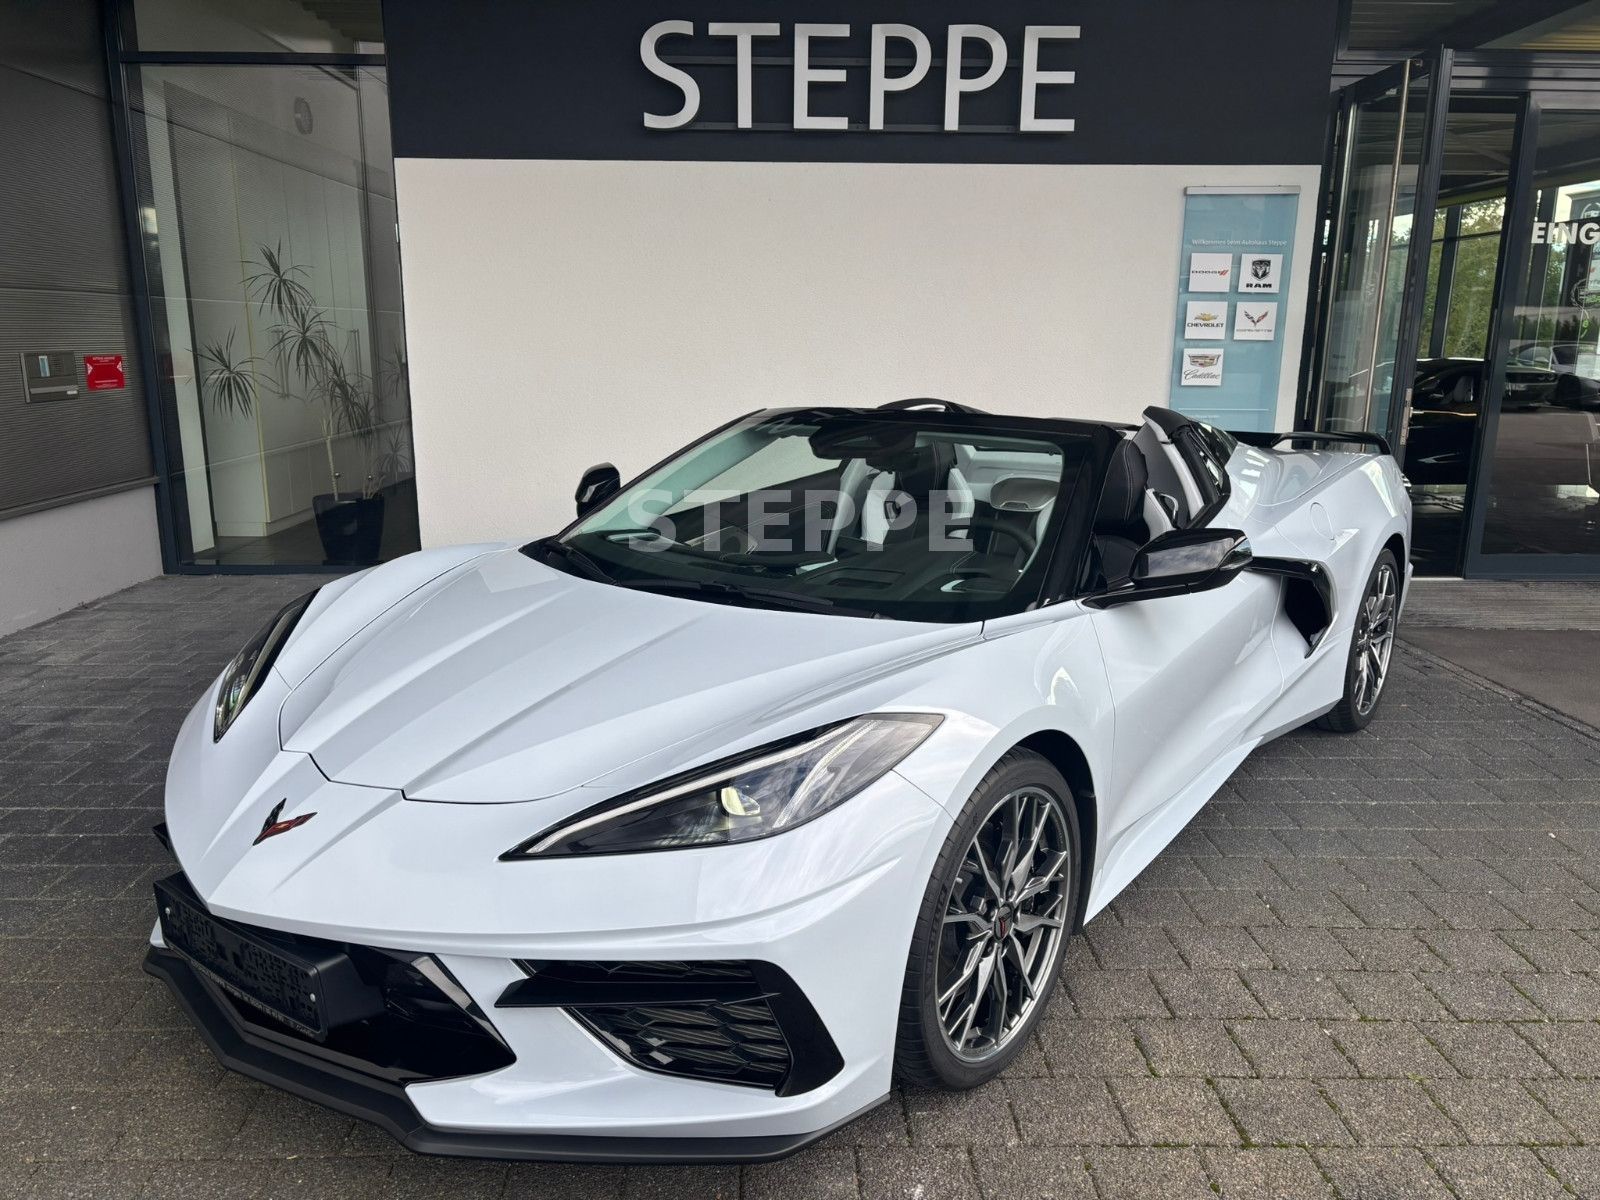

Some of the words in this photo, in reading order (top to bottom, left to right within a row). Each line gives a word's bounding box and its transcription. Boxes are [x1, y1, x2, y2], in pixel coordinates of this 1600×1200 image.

[639, 19, 1081, 132] STEPPE
[1530, 221, 1600, 245] EING
[1183, 368, 1220, 380] Cadillac
